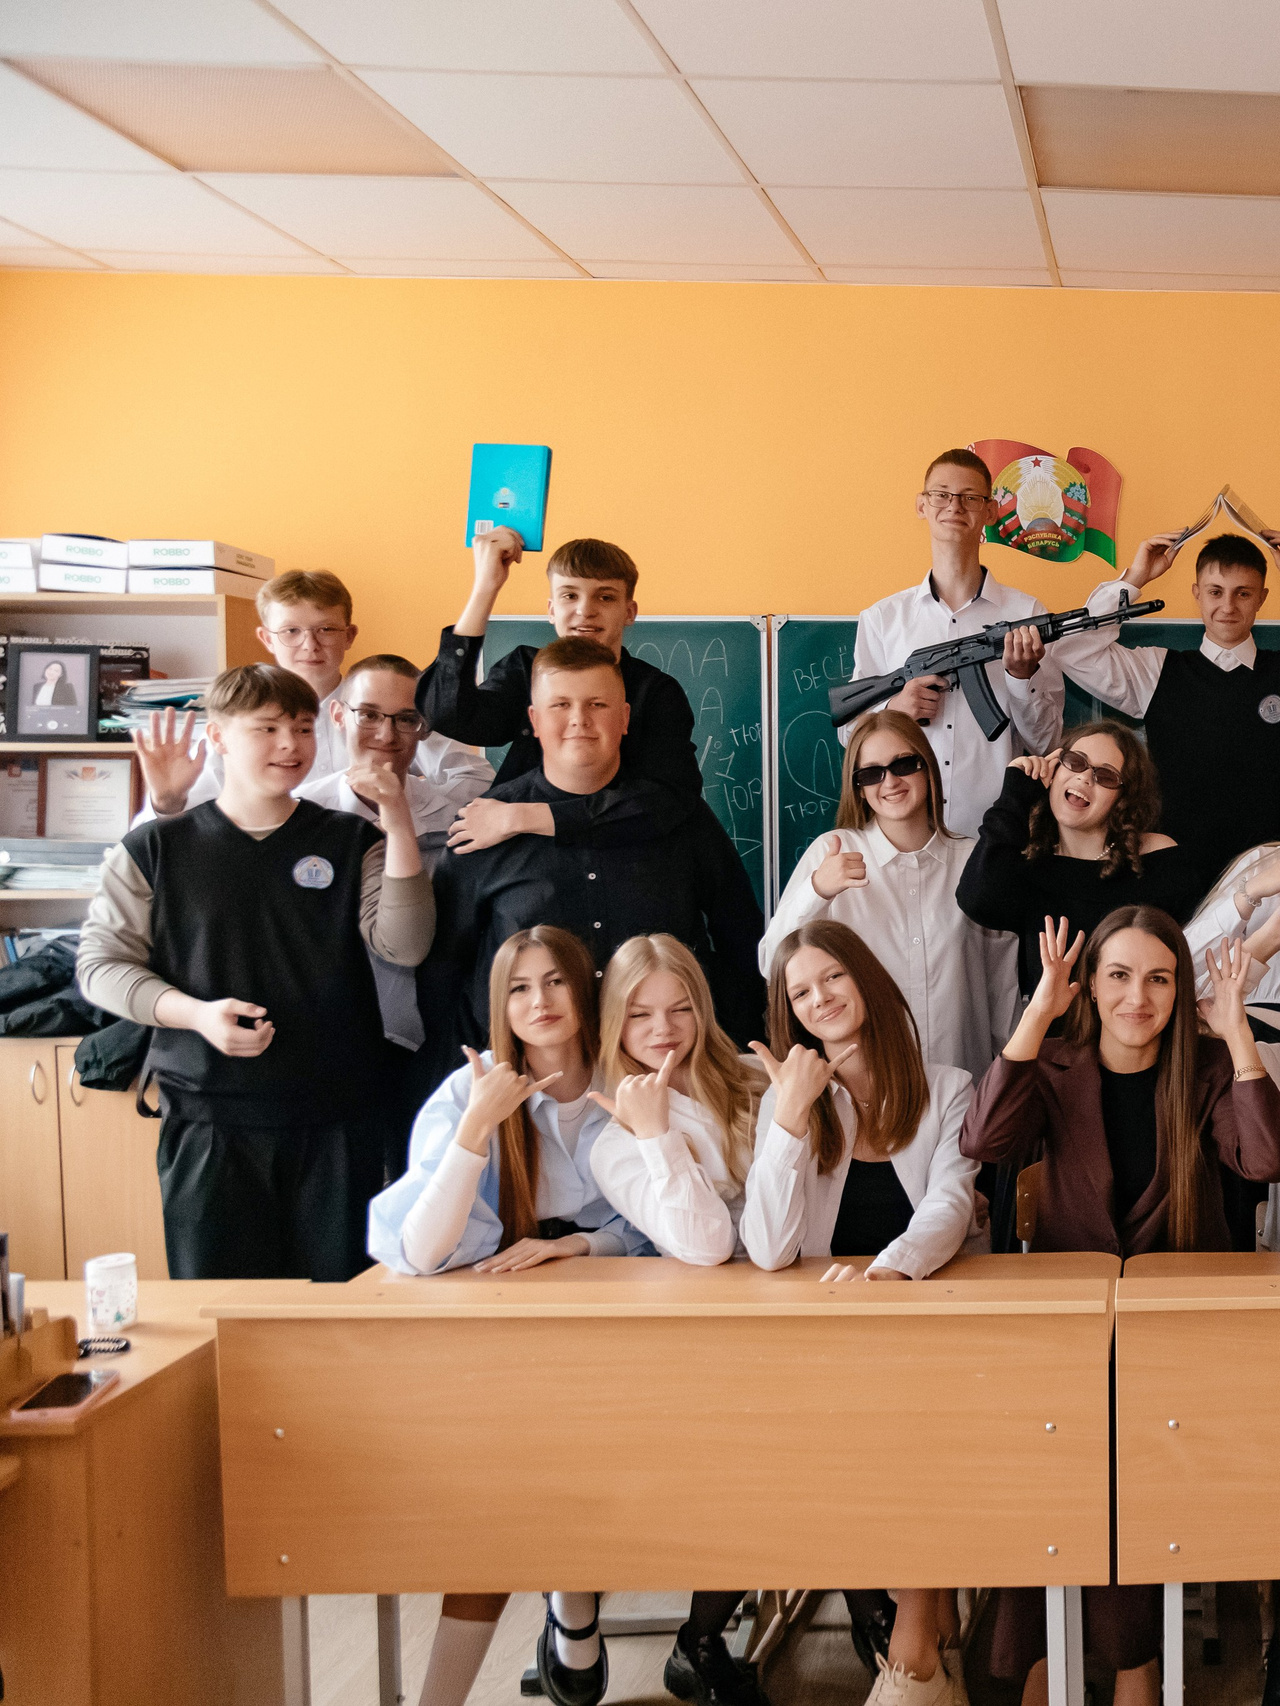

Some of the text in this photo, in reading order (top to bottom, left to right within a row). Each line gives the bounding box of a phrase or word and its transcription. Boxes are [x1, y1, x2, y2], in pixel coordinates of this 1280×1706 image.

[1027, 540, 1060, 549] БЕЛАРУСЬ
[66, 545, 103, 557] ROBBO
[153, 547, 190, 557] ROBBO
[64, 573, 101, 583] ROBBO
[153, 576, 190, 586] ROBBO
